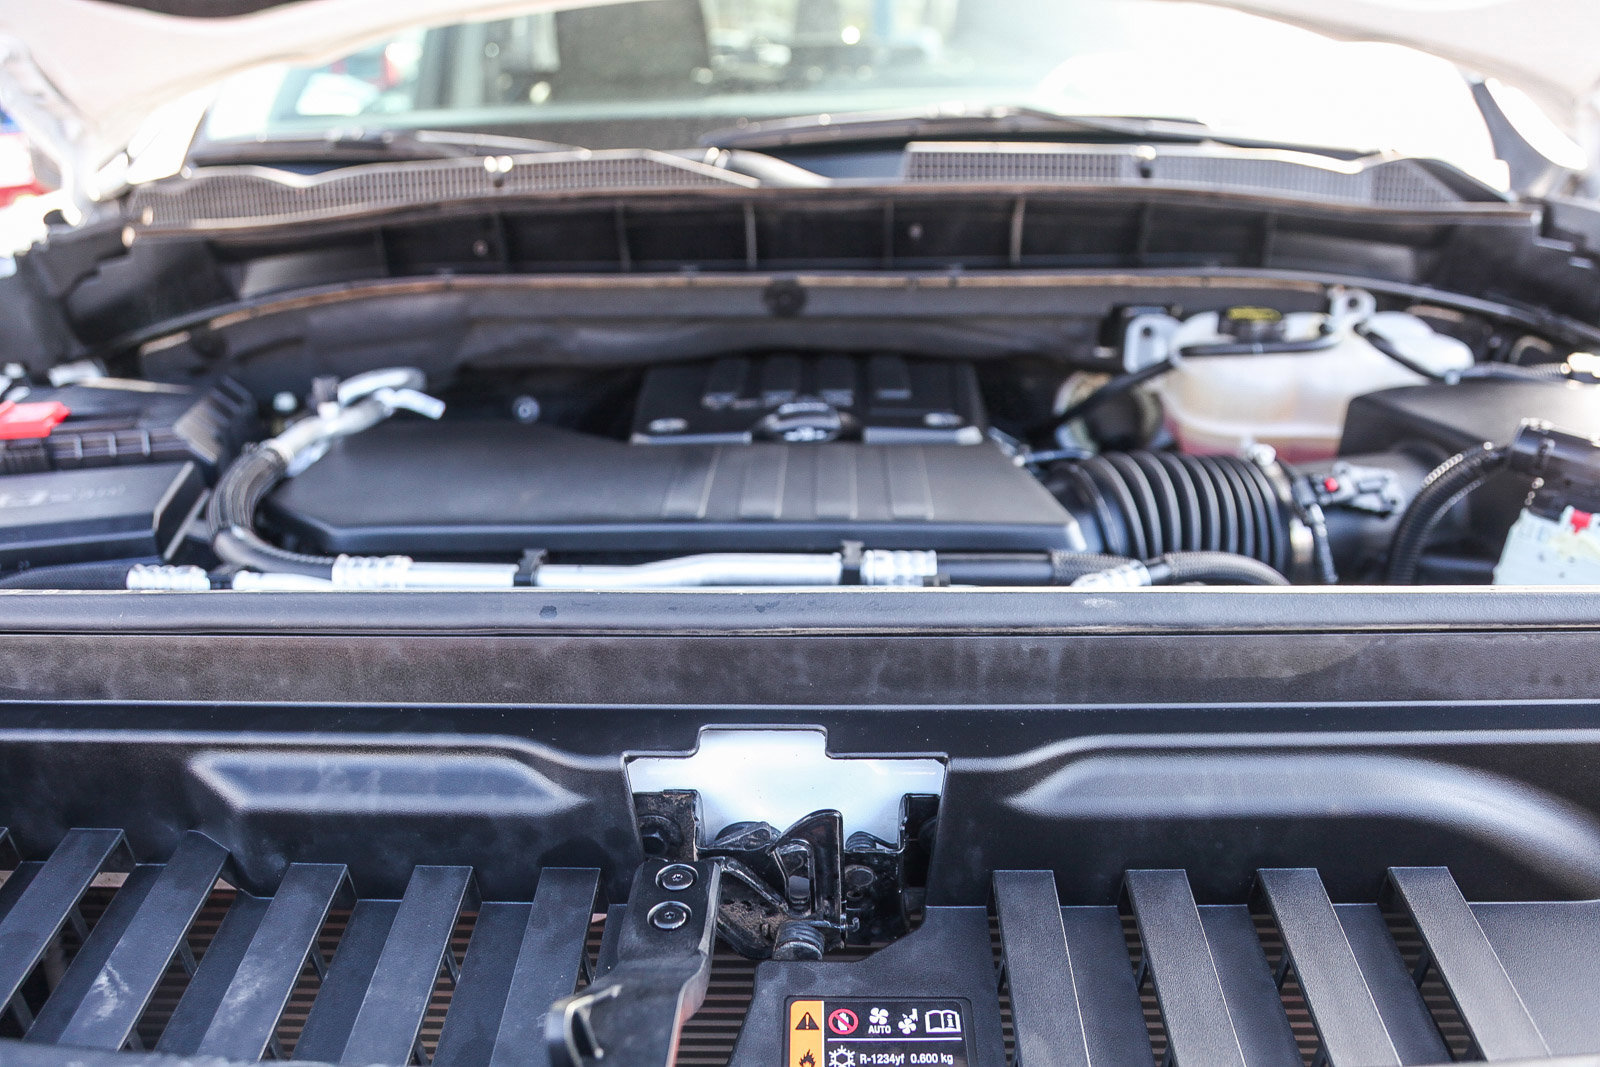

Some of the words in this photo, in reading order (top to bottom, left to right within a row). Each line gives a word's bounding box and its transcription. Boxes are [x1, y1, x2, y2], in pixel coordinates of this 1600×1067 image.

[868, 1025, 891, 1034] AUTO
[859, 1053, 905, 1066] R-1234yf
[910, 1053, 938, 1064] 0.600
[940, 1052, 954, 1065] kg
